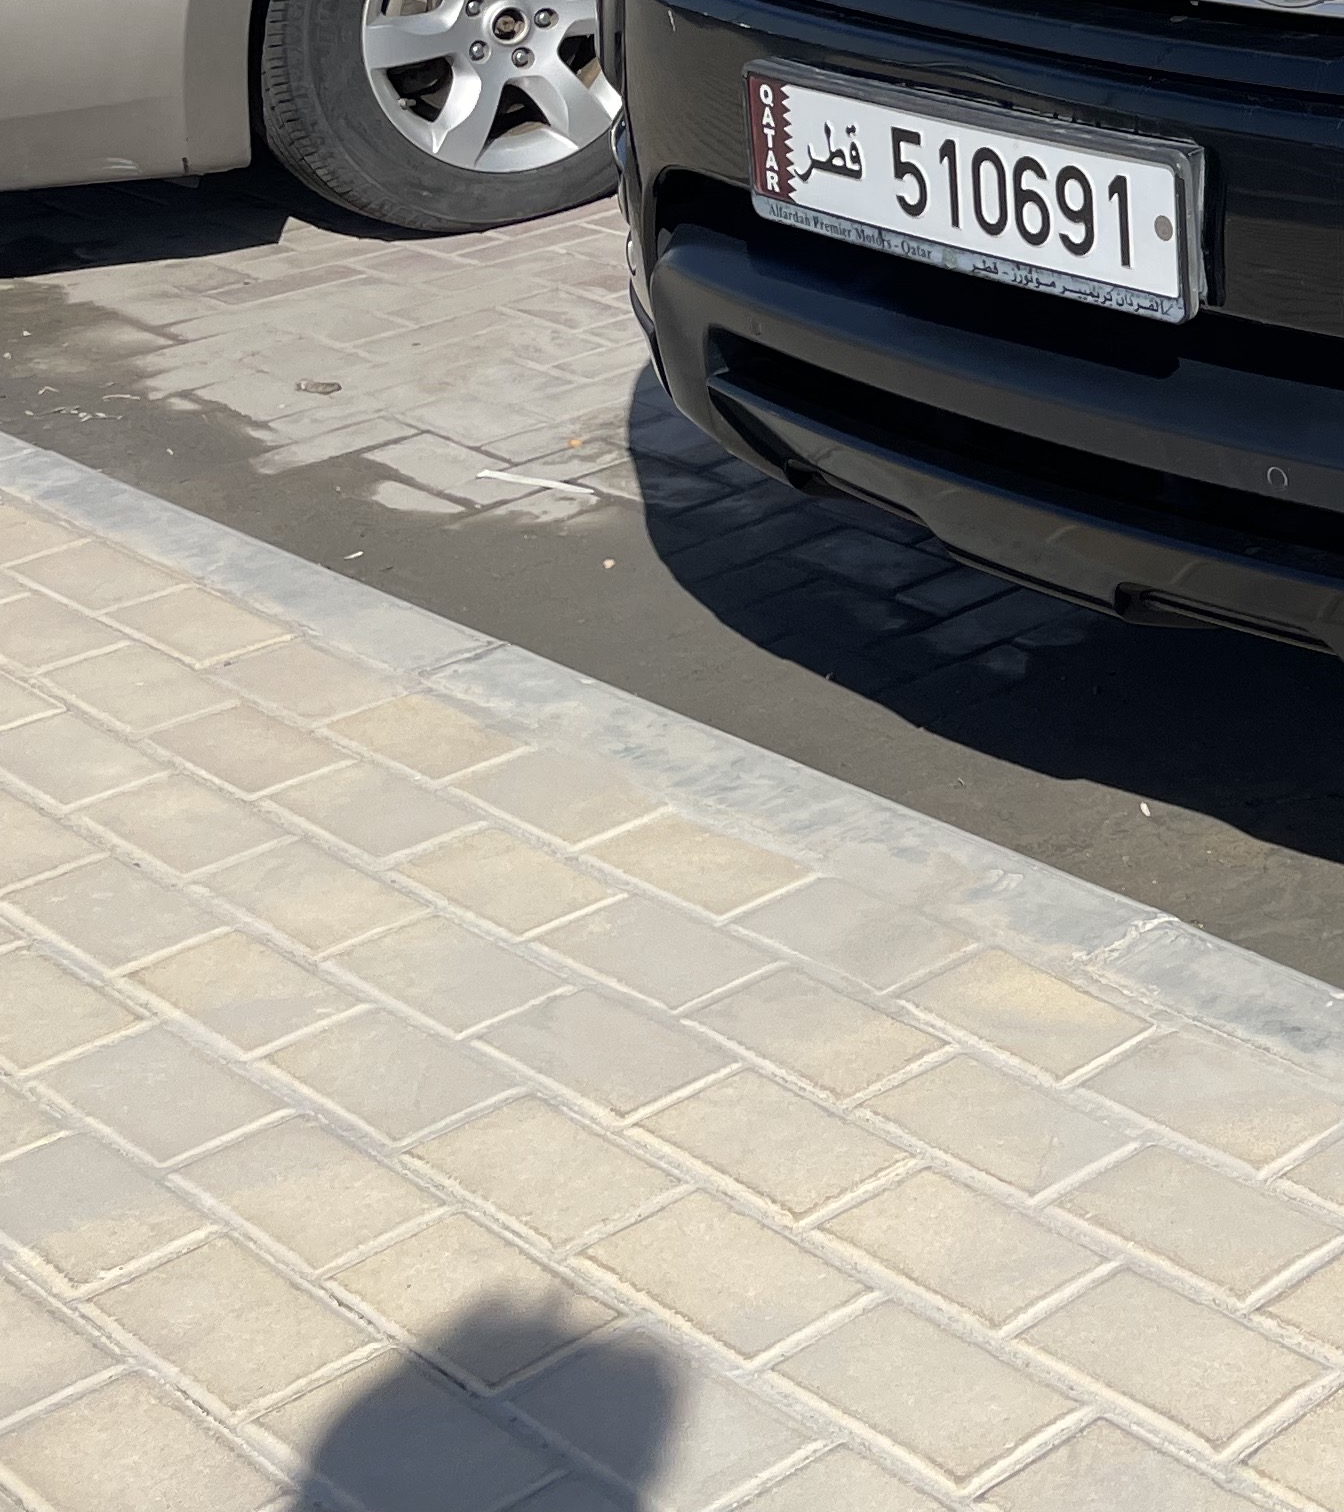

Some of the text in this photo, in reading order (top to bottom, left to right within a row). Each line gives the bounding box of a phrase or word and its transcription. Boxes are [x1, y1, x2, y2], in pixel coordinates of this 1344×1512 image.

[759, 83, 781, 193] QATAR
[795, 121, 864, 182] قطر
[812, 215, 853, 238] Premier
[900, 239, 933, 260] Qatar
[890, 126, 1131, 269] 510691
